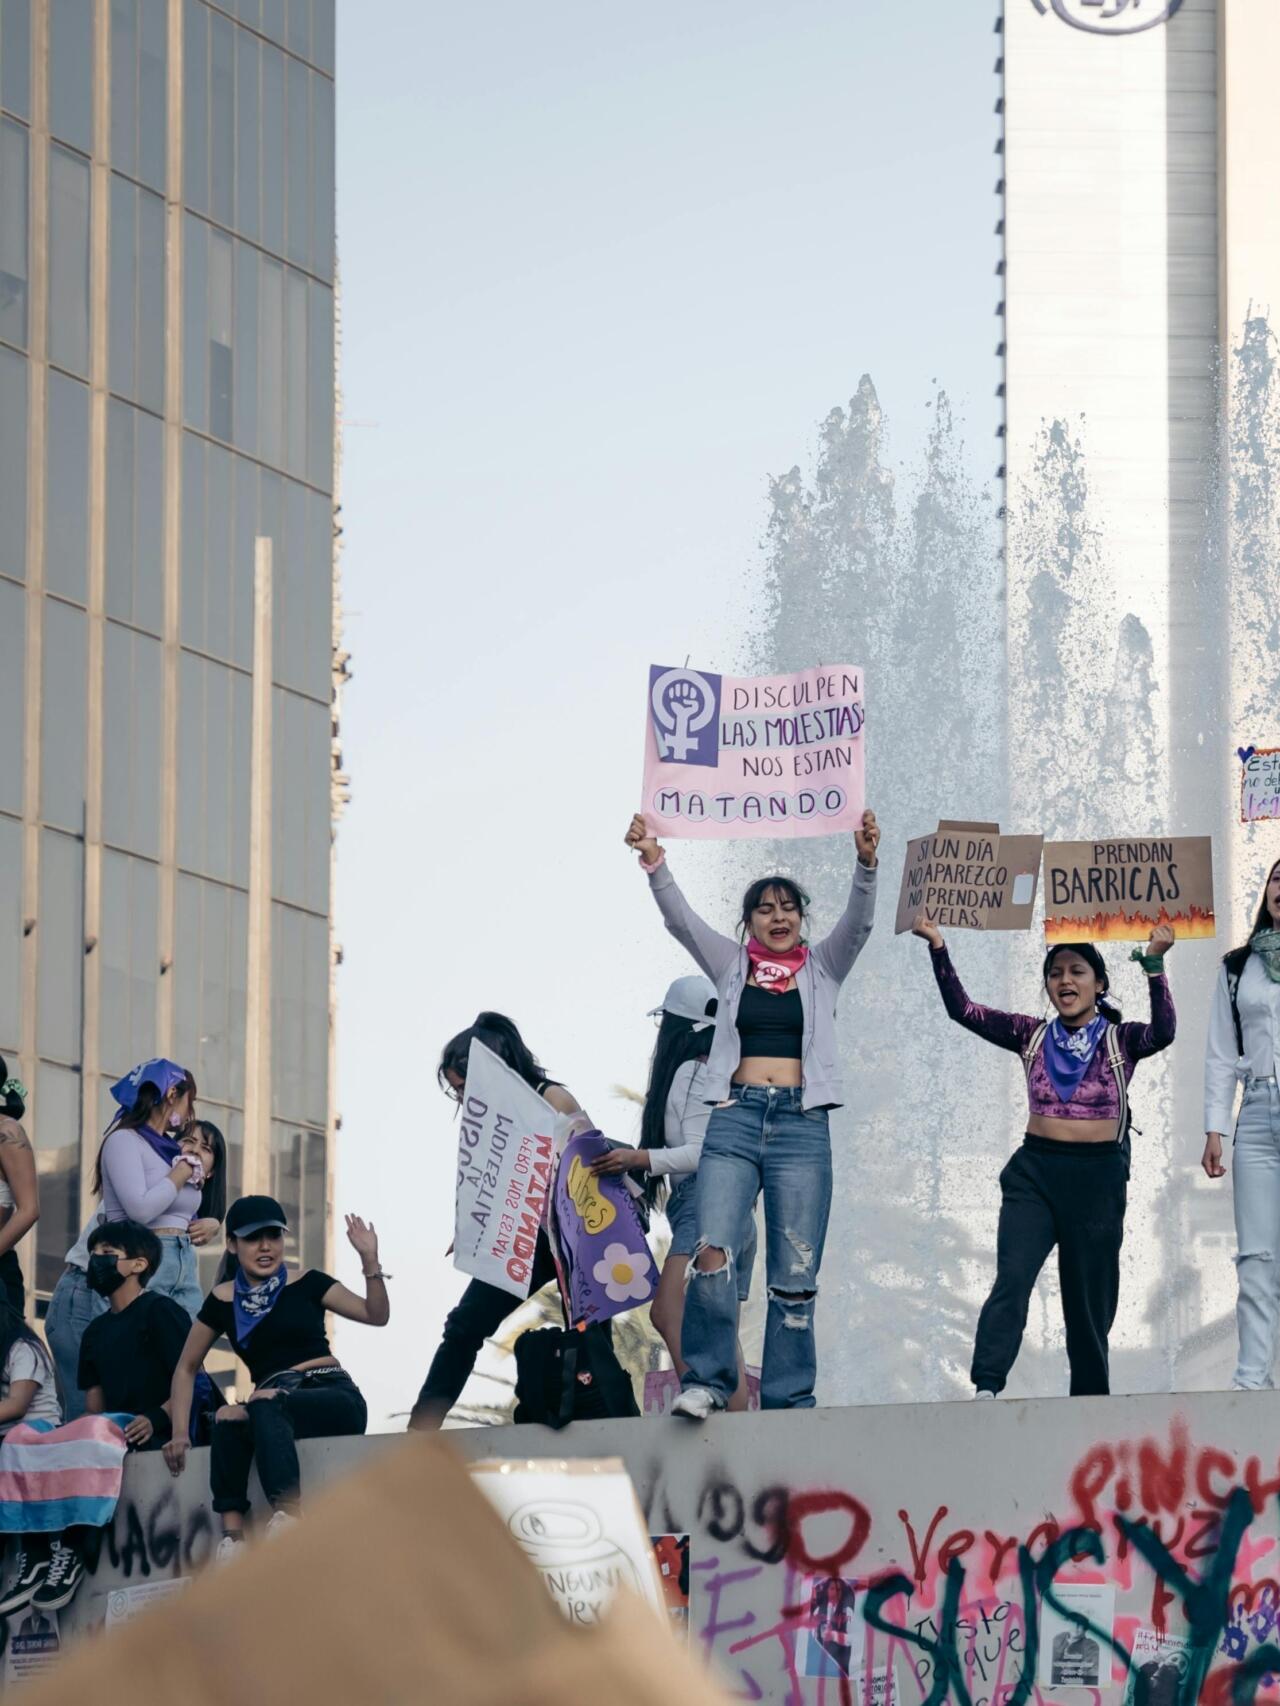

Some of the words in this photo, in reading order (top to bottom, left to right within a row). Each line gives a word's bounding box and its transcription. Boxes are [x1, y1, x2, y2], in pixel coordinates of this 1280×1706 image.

[733, 674, 858, 711] DISCULPEN
[722, 719, 757, 747] LAS
[743, 757, 783, 777] NOS
[794, 746, 852, 776] ESTAN
[661, 790, 841, 818] MATANDO
[917, 840, 929, 863] SI
[932, 838, 960, 859] UN
[966, 837, 994, 862] DÍA
[1094, 842, 1173, 865] PRENDAN
[907, 867, 923, 888] NO
[1051, 863, 1181, 905] BARRICAS
[908, 888, 923, 909] NO
[926, 887, 1003, 908] PRENDAN
